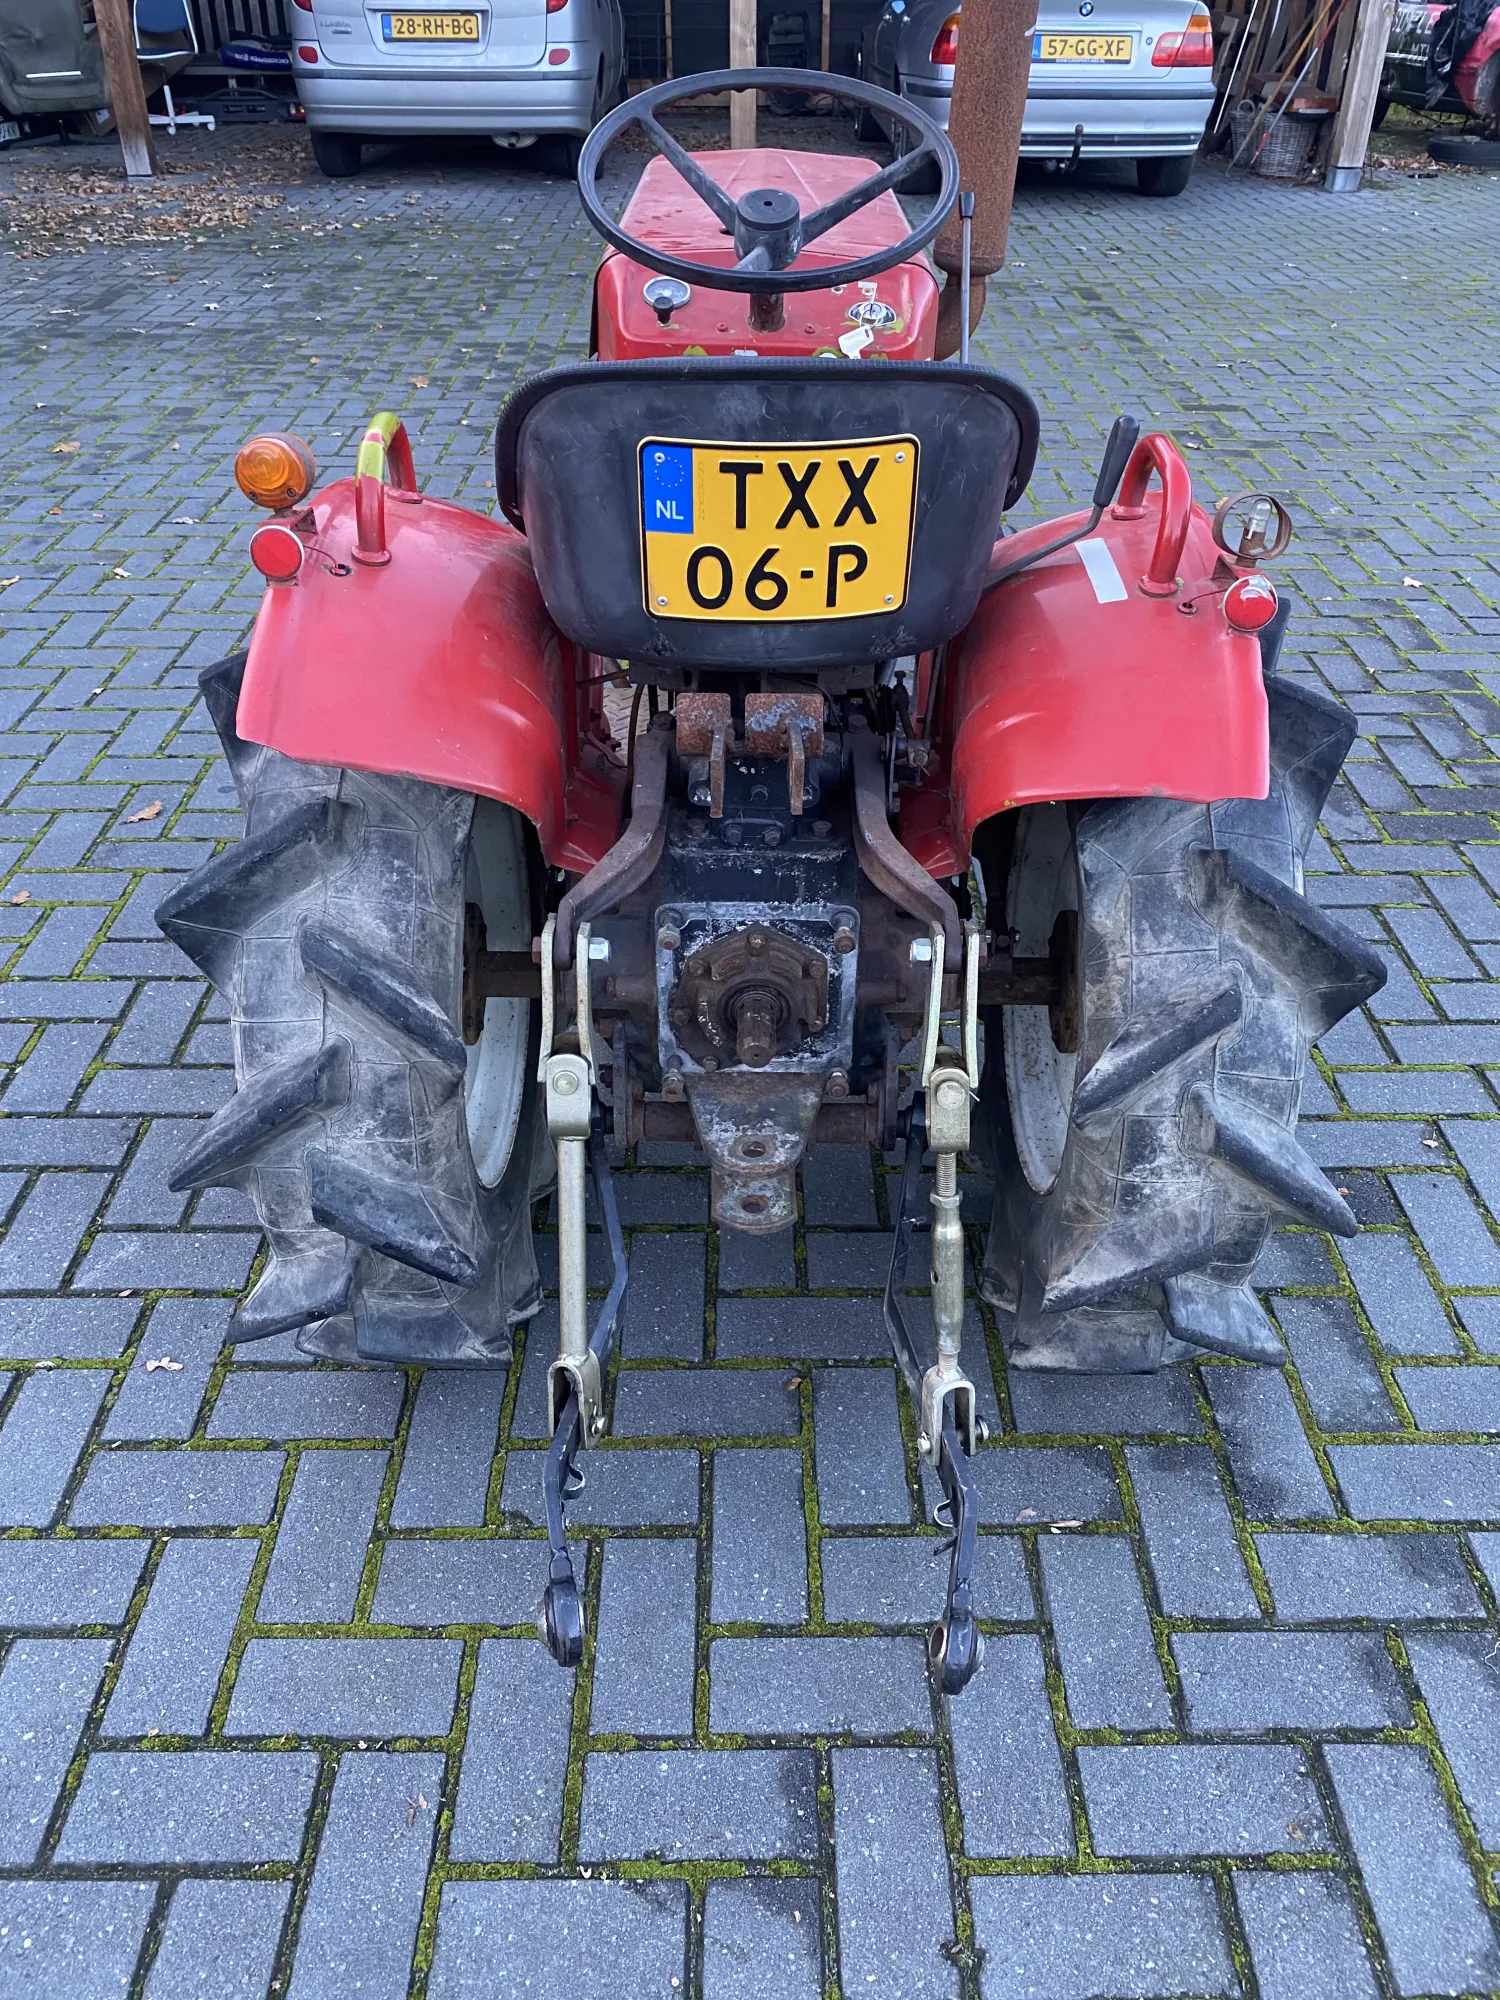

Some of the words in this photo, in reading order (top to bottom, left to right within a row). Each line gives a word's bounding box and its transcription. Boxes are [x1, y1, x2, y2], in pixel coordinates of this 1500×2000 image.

[395, 18, 473, 35] 28-RH-BG
[1048, 39, 1126, 56] 57-GG-XF
[719, 457, 880, 529] TXX
[656, 500, 684, 520] NL
[686, 543, 868, 611] 06-P
